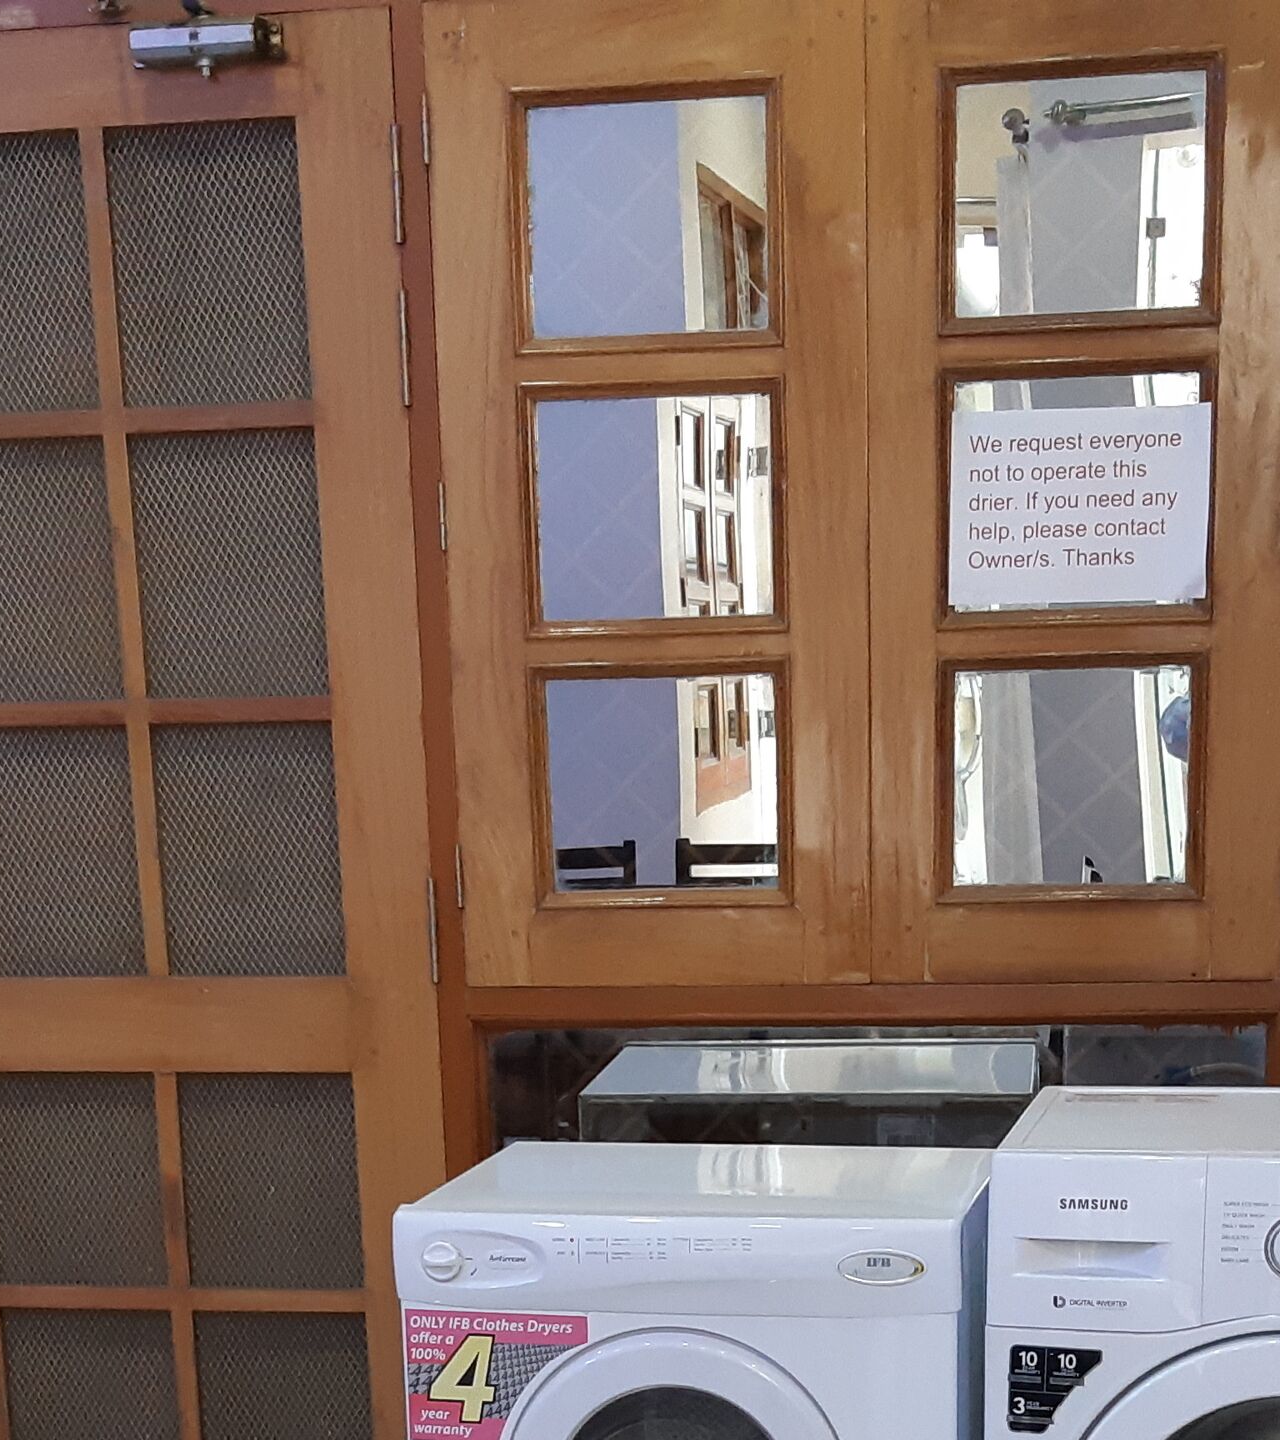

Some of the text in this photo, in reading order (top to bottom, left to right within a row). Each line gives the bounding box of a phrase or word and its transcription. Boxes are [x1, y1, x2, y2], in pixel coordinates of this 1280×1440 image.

[969, 432, 1182, 455] We request everyone
[969, 459, 1147, 485] not to operate this
[969, 490, 1178, 514] drier. If you need any
[969, 518, 1166, 544] help, please contact
[968, 548, 1135, 570] Owner/s. Thanks
[1059, 1198, 1128, 1210] SAMSUNG
[1069, 1299, 1128, 1308] DIGITAL INVERTER
[410, 1316, 573, 1336] ONLY IFB Clothes Dryers
[410, 1331, 454, 1345] offer a
[410, 1347, 446, 1361] 100%
[1019, 1351, 1038, 1367] 10
[1057, 1353, 1077, 1369] 10
[428, 1333, 496, 1424] 4
[1012, 1397, 1025, 1414] 3
[420, 1408, 450, 1421] year
[414, 1424, 472, 1438] warranty
